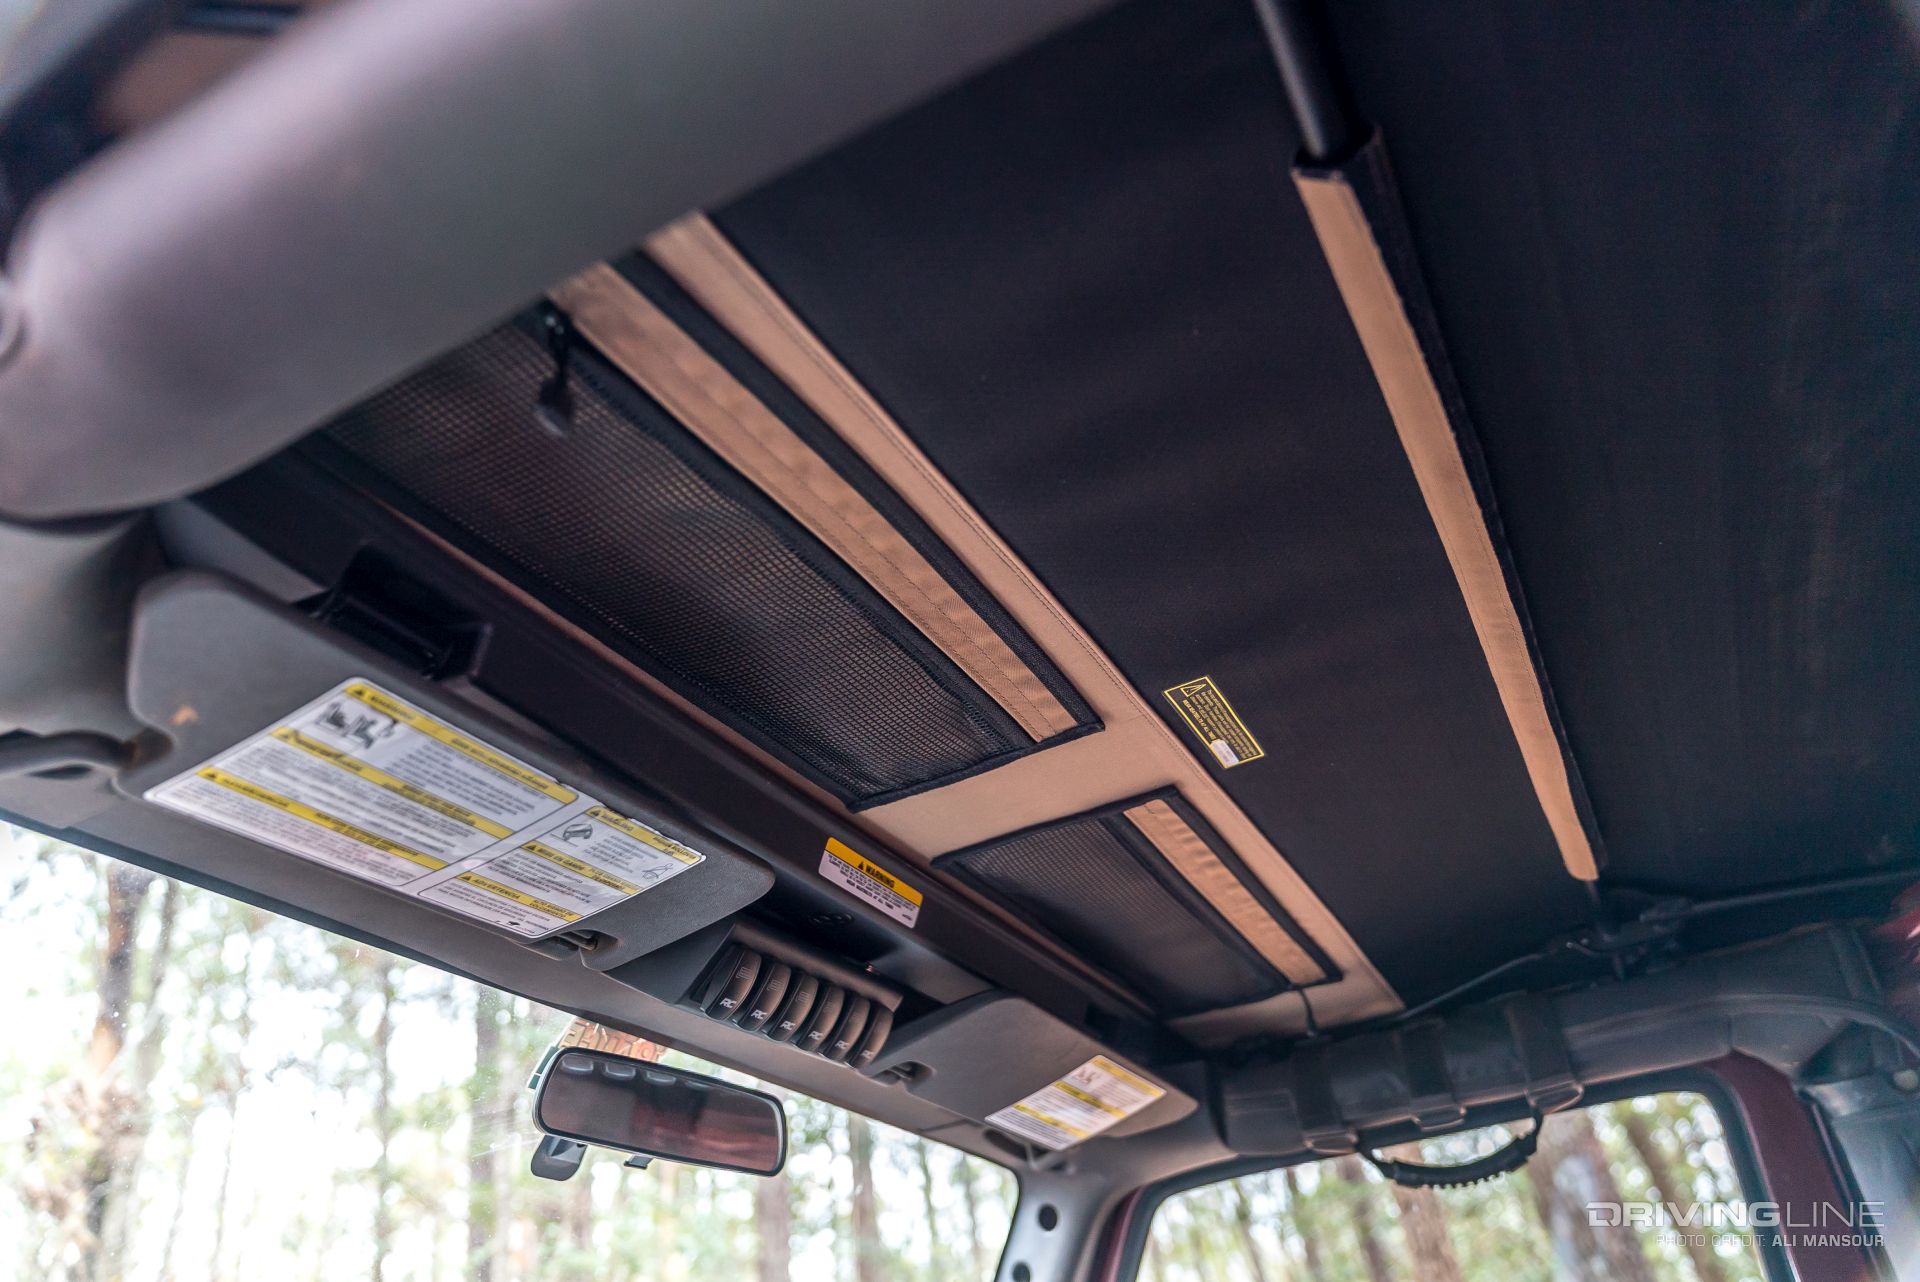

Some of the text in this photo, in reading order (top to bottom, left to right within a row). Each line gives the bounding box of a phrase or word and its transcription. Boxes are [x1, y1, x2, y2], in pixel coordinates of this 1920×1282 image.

[720, 998, 737, 1009] RC
[751, 1009, 768, 1020] RC
[780, 1020, 796, 1031] RC
